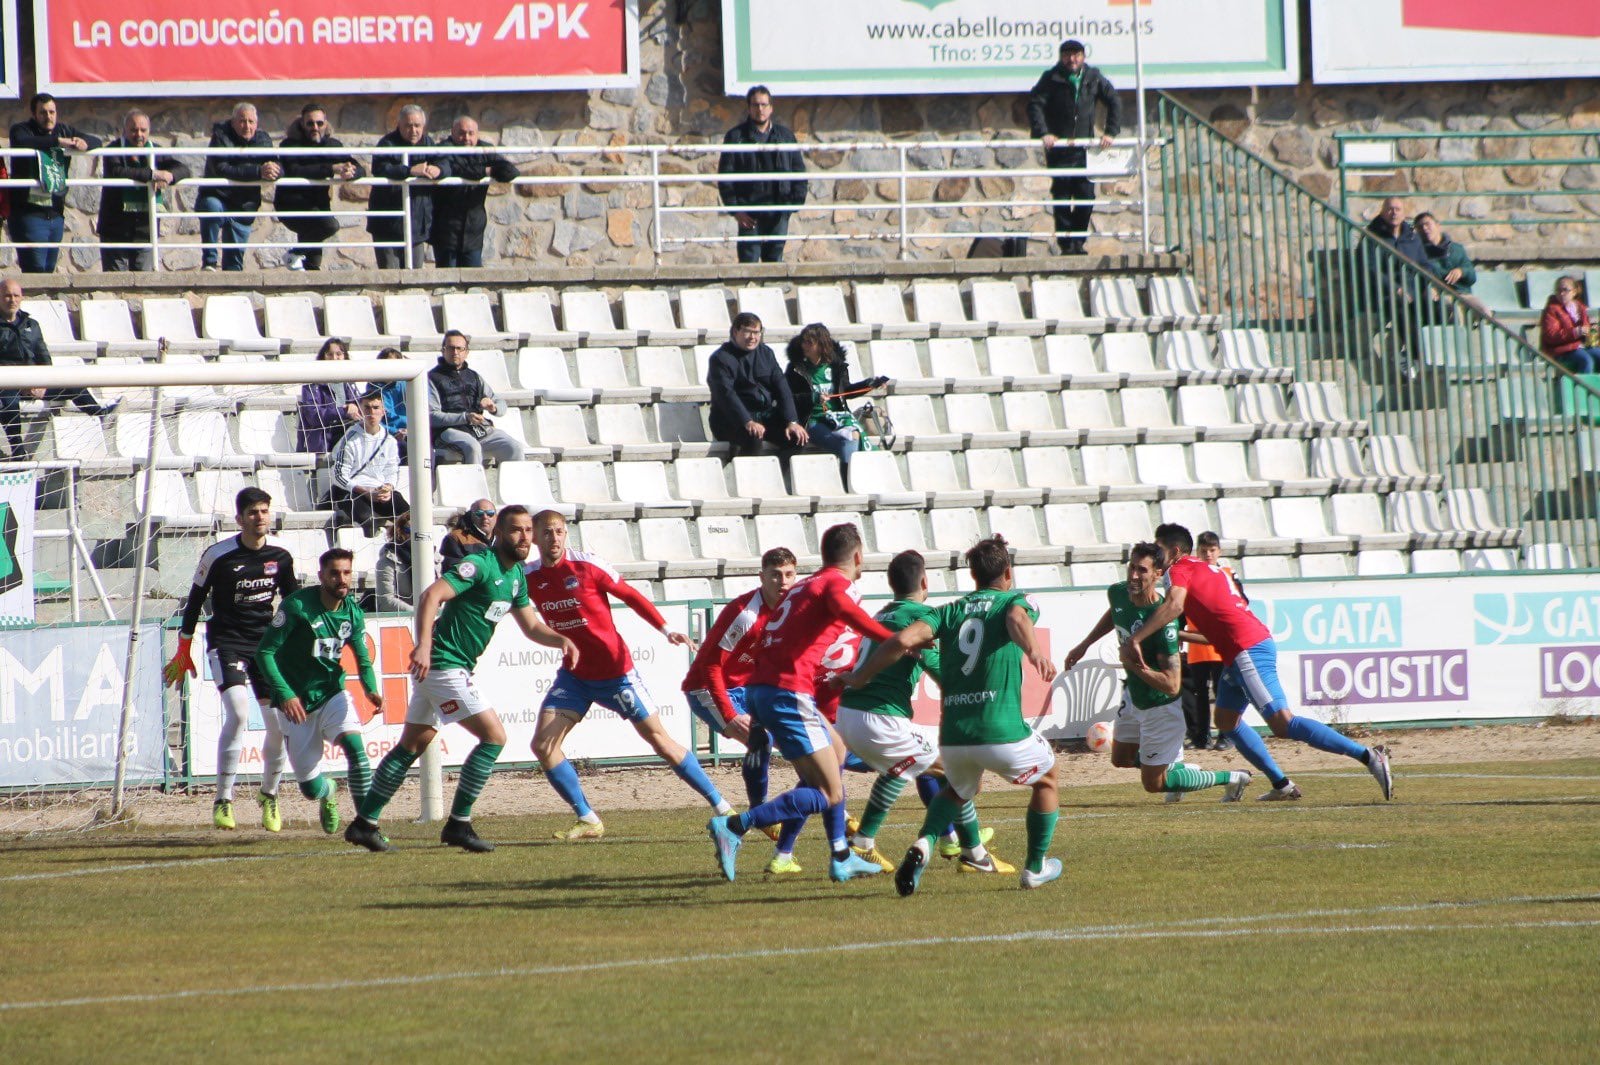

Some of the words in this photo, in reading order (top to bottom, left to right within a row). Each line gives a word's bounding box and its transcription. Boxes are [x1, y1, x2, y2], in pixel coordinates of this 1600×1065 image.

[73, 20, 111, 47] LA
[119, 9, 304, 47] CONDUCCIÓN
[312, 15, 434, 44] ABIERTA
[447, 17, 483, 46] by
[493, 2, 590, 41] APK
[928, 44, 977, 62] Tfno:
[981, 44, 1015, 61] 925
[1020, 43, 1054, 61] 253
[1303, 602, 1397, 645] GATA
[958, 618, 985, 677] 9
[1303, 654, 1465, 701] LOGISTIC
[612, 688, 636, 714] 19
